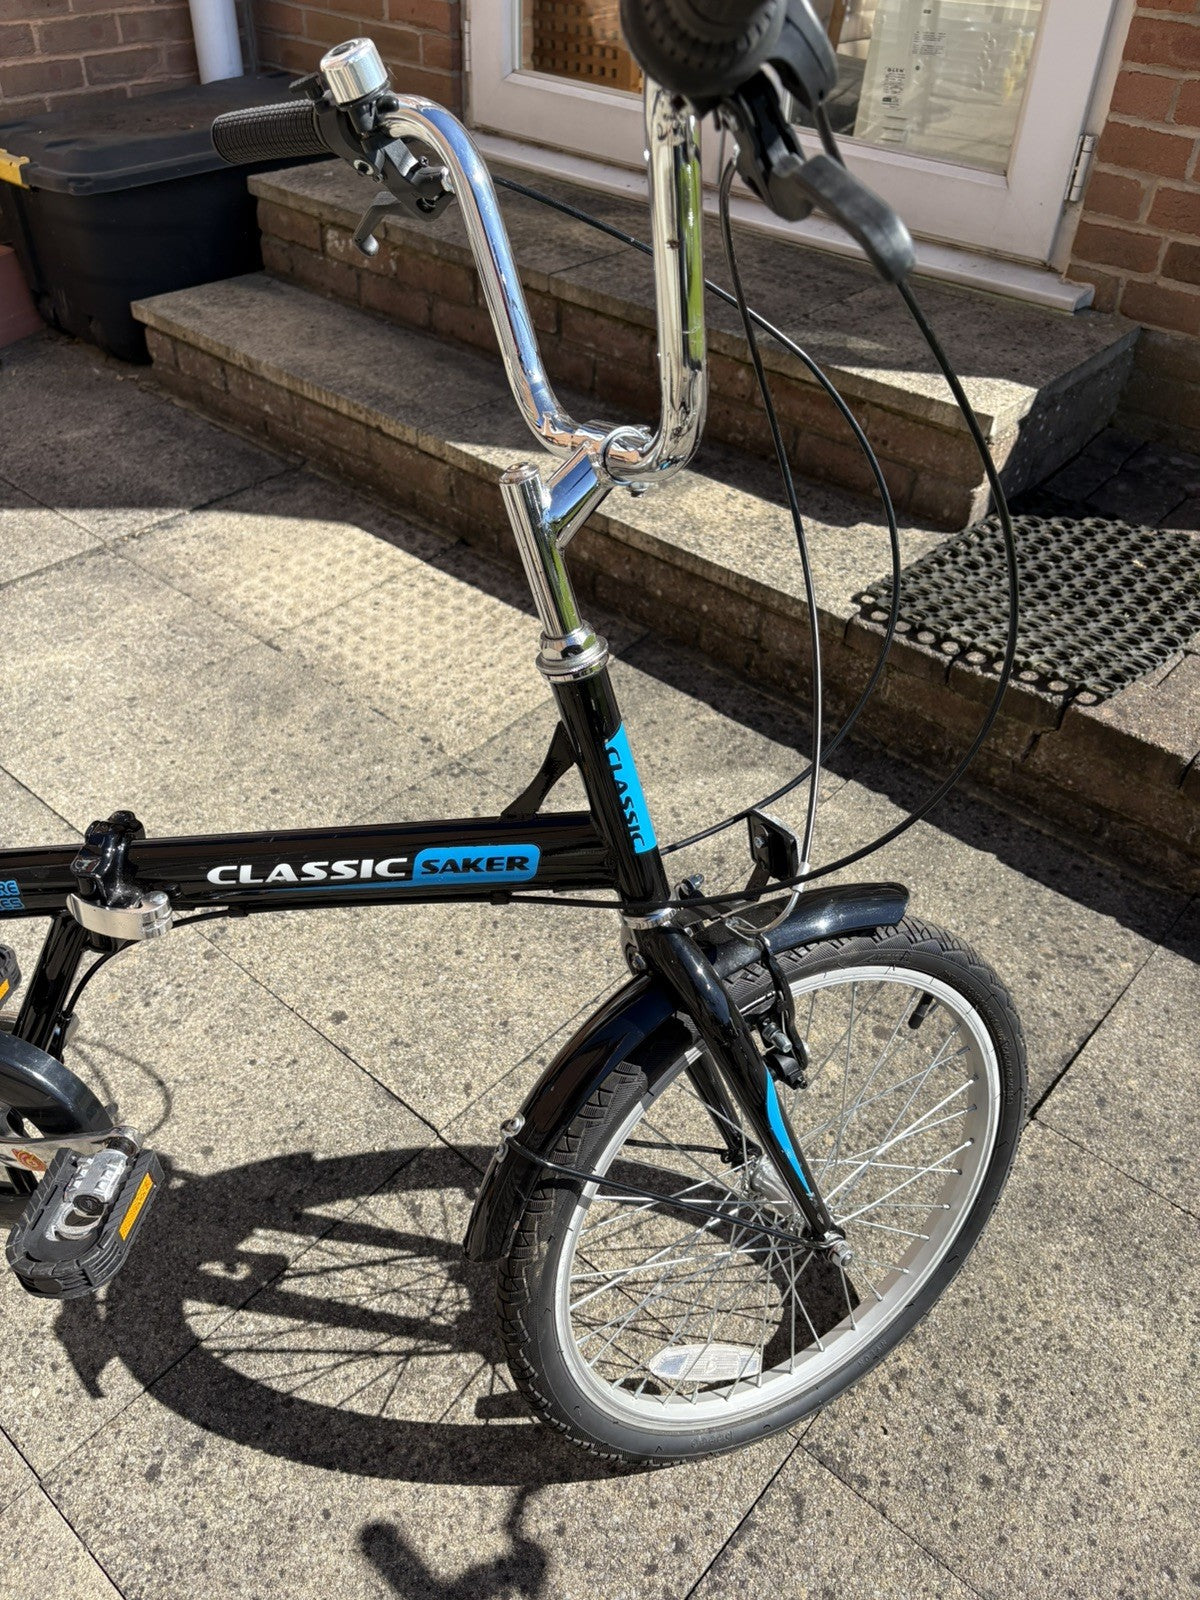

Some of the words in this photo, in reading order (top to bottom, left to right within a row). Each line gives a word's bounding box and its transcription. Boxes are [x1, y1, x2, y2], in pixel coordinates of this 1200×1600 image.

[604, 745, 646, 850] CLASSIC
[207, 857, 408, 885] CLASSIC
[421, 855, 530, 875] SAKER
